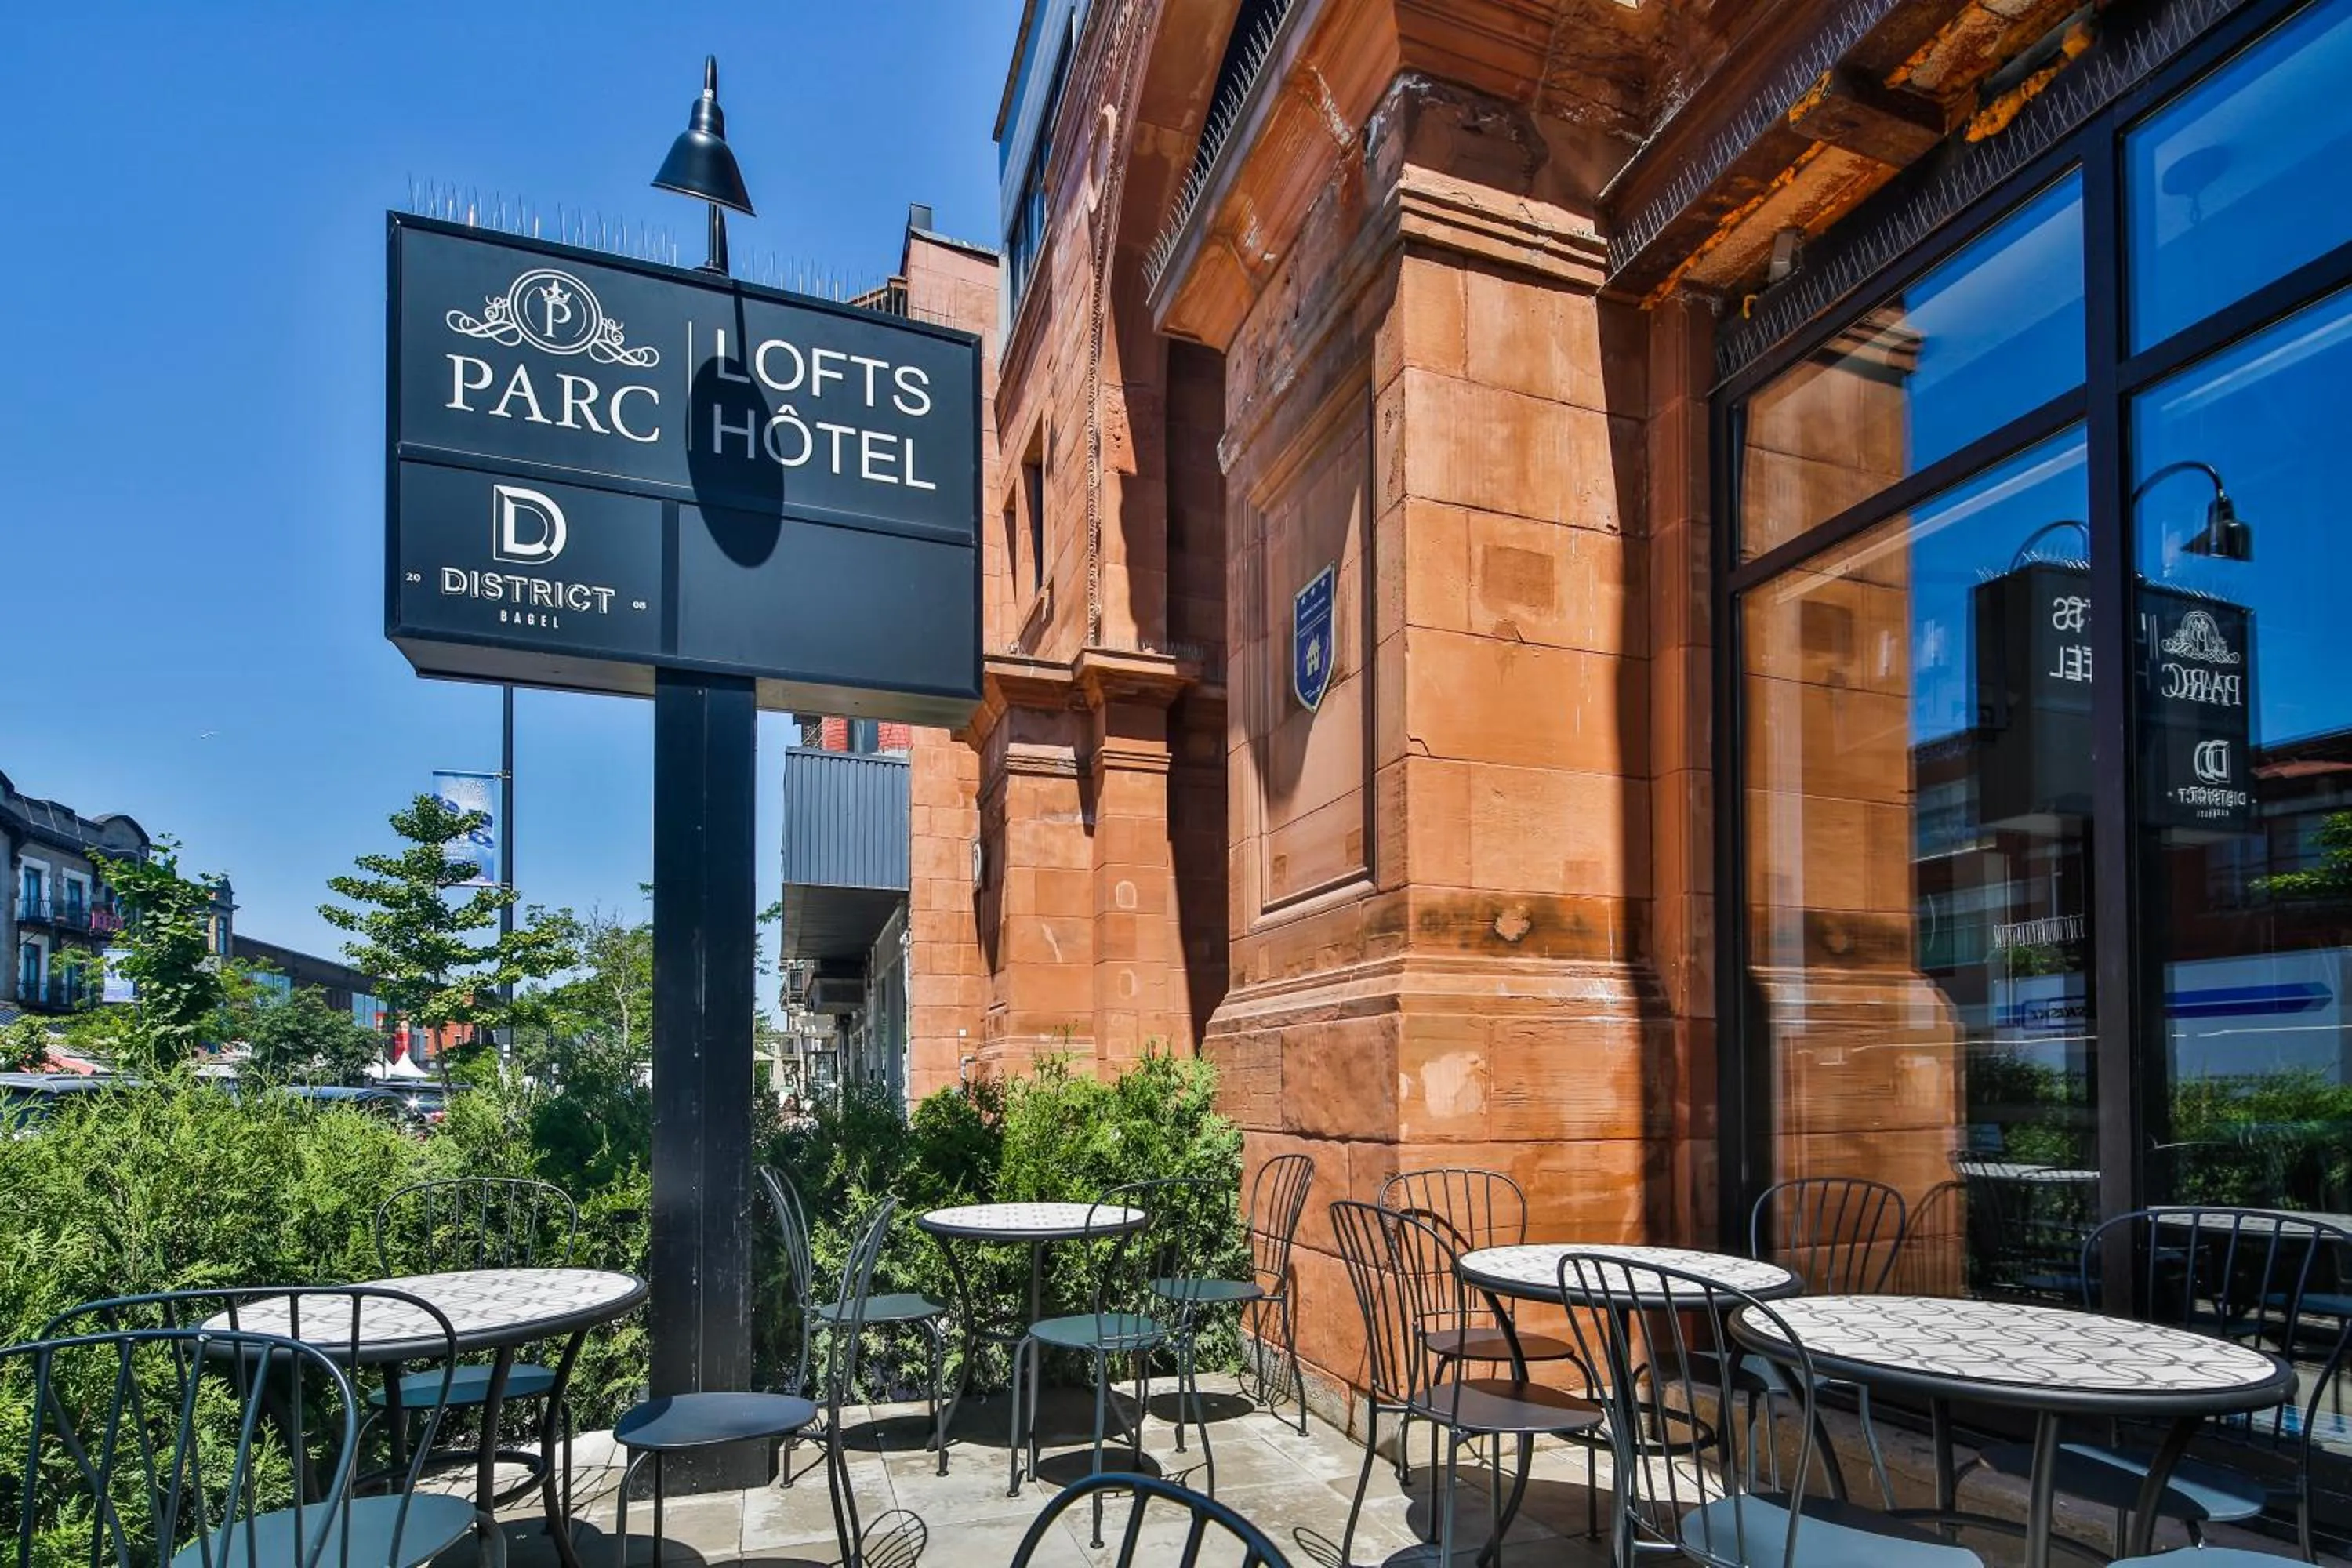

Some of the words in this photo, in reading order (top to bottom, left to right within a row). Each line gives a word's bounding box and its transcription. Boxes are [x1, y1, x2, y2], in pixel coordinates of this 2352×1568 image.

[543, 300, 572, 339] P
[445, 353, 661, 443] PARC
[716, 328, 932, 417] LOFTS
[713, 403, 937, 491] HÔTEL
[492, 483, 568, 565] D
[405, 572, 421, 583] 20
[441, 566, 615, 614] DISTRICT
[499, 608, 559, 628] BAGEL
